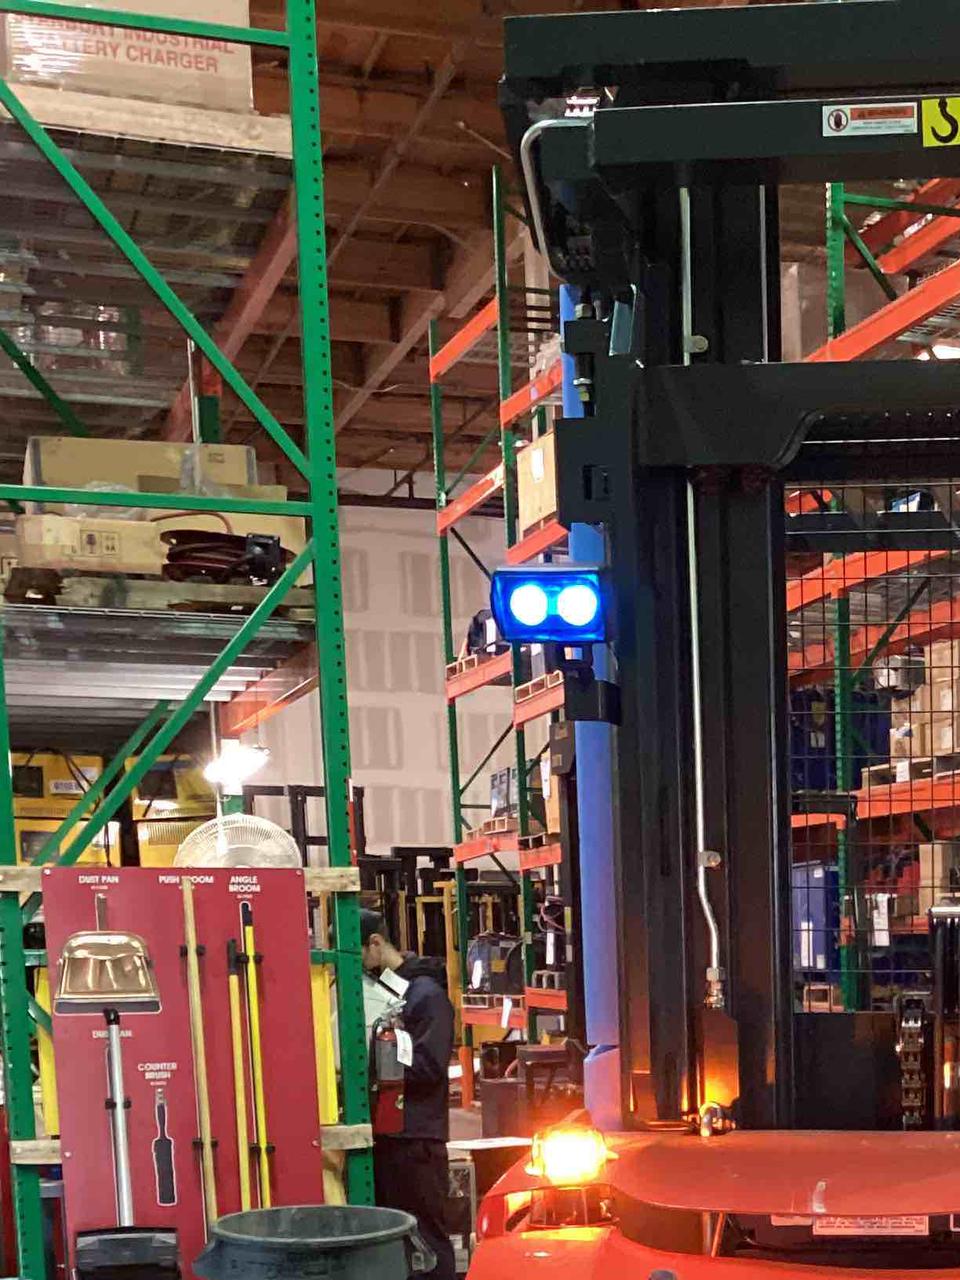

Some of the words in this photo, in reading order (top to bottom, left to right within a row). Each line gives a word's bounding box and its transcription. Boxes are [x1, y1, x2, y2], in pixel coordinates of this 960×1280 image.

[123, 27, 235, 54] INDUSTRIAL
[126, 45, 219, 73] CHARGER
[78, 875, 99, 884] DUST
[101, 875, 119, 884] PAN
[158, 875, 180, 884] PUSH
[230, 875, 258, 884] ANGLE
[228, 884, 261, 892] BROOM
[137, 1062, 178, 1072] COUNTER
